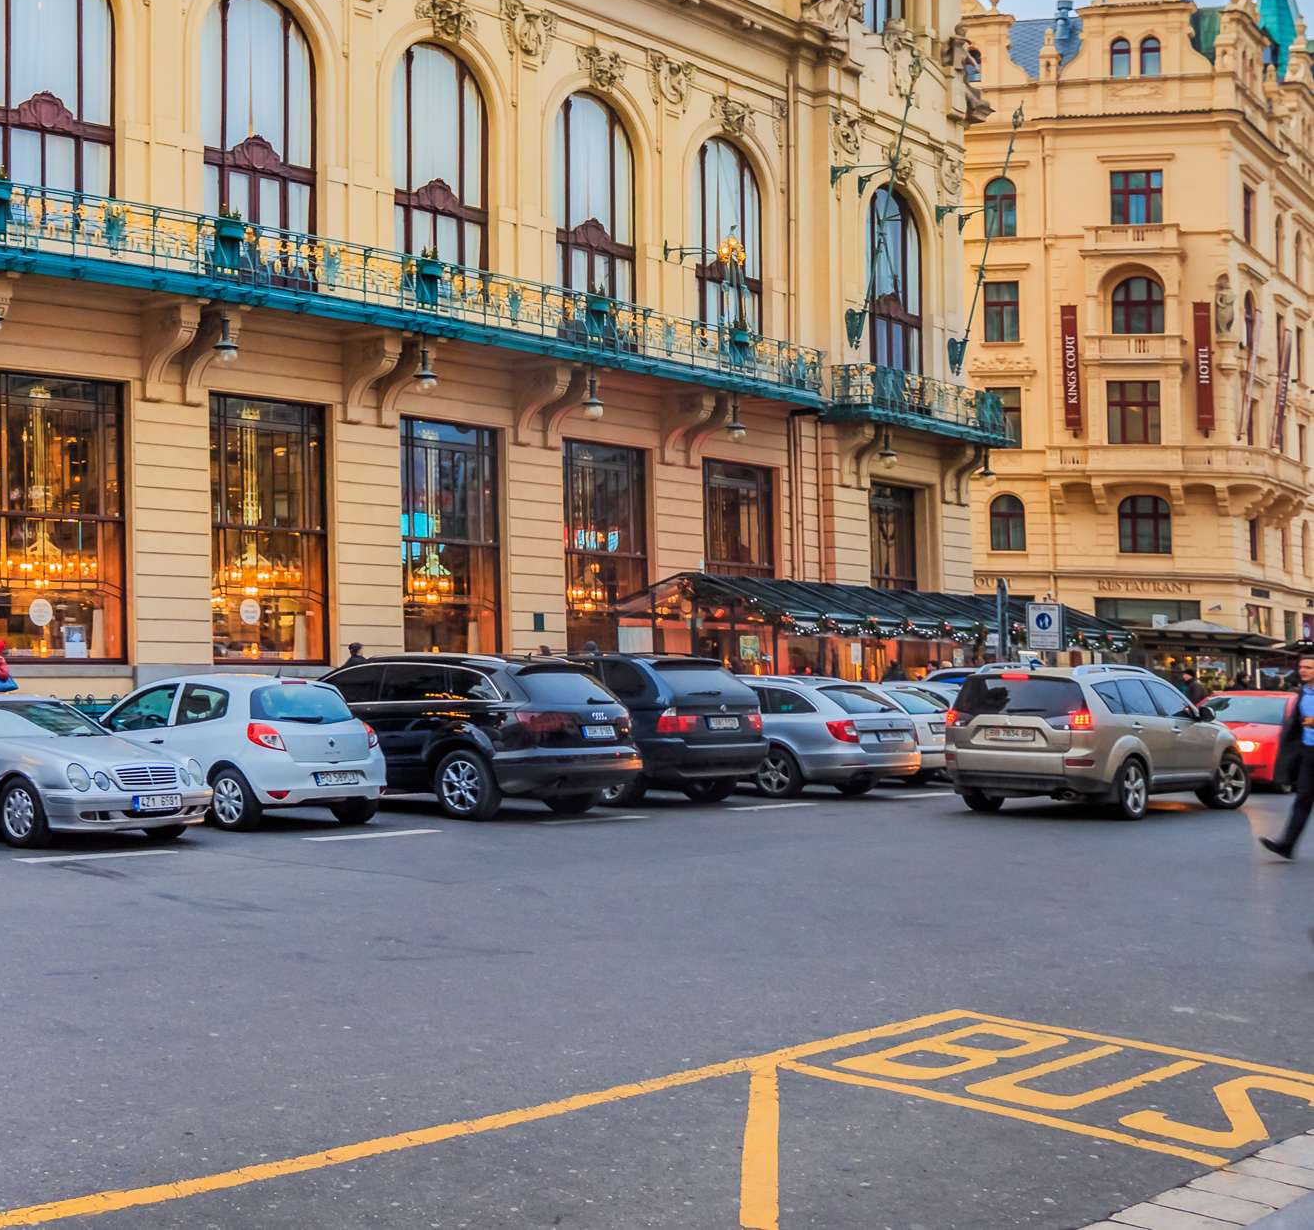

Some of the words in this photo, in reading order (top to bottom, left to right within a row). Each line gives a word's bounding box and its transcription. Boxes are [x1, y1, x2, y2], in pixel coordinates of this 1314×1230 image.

[1065, 335, 1077, 369] COURT
[1198, 346, 1210, 384] HOTEL
[1067, 370, 1078, 404] KINGS
[1098, 579, 1193, 594] RESTAURANT
[832, 1022, 1314, 1148] BUS
